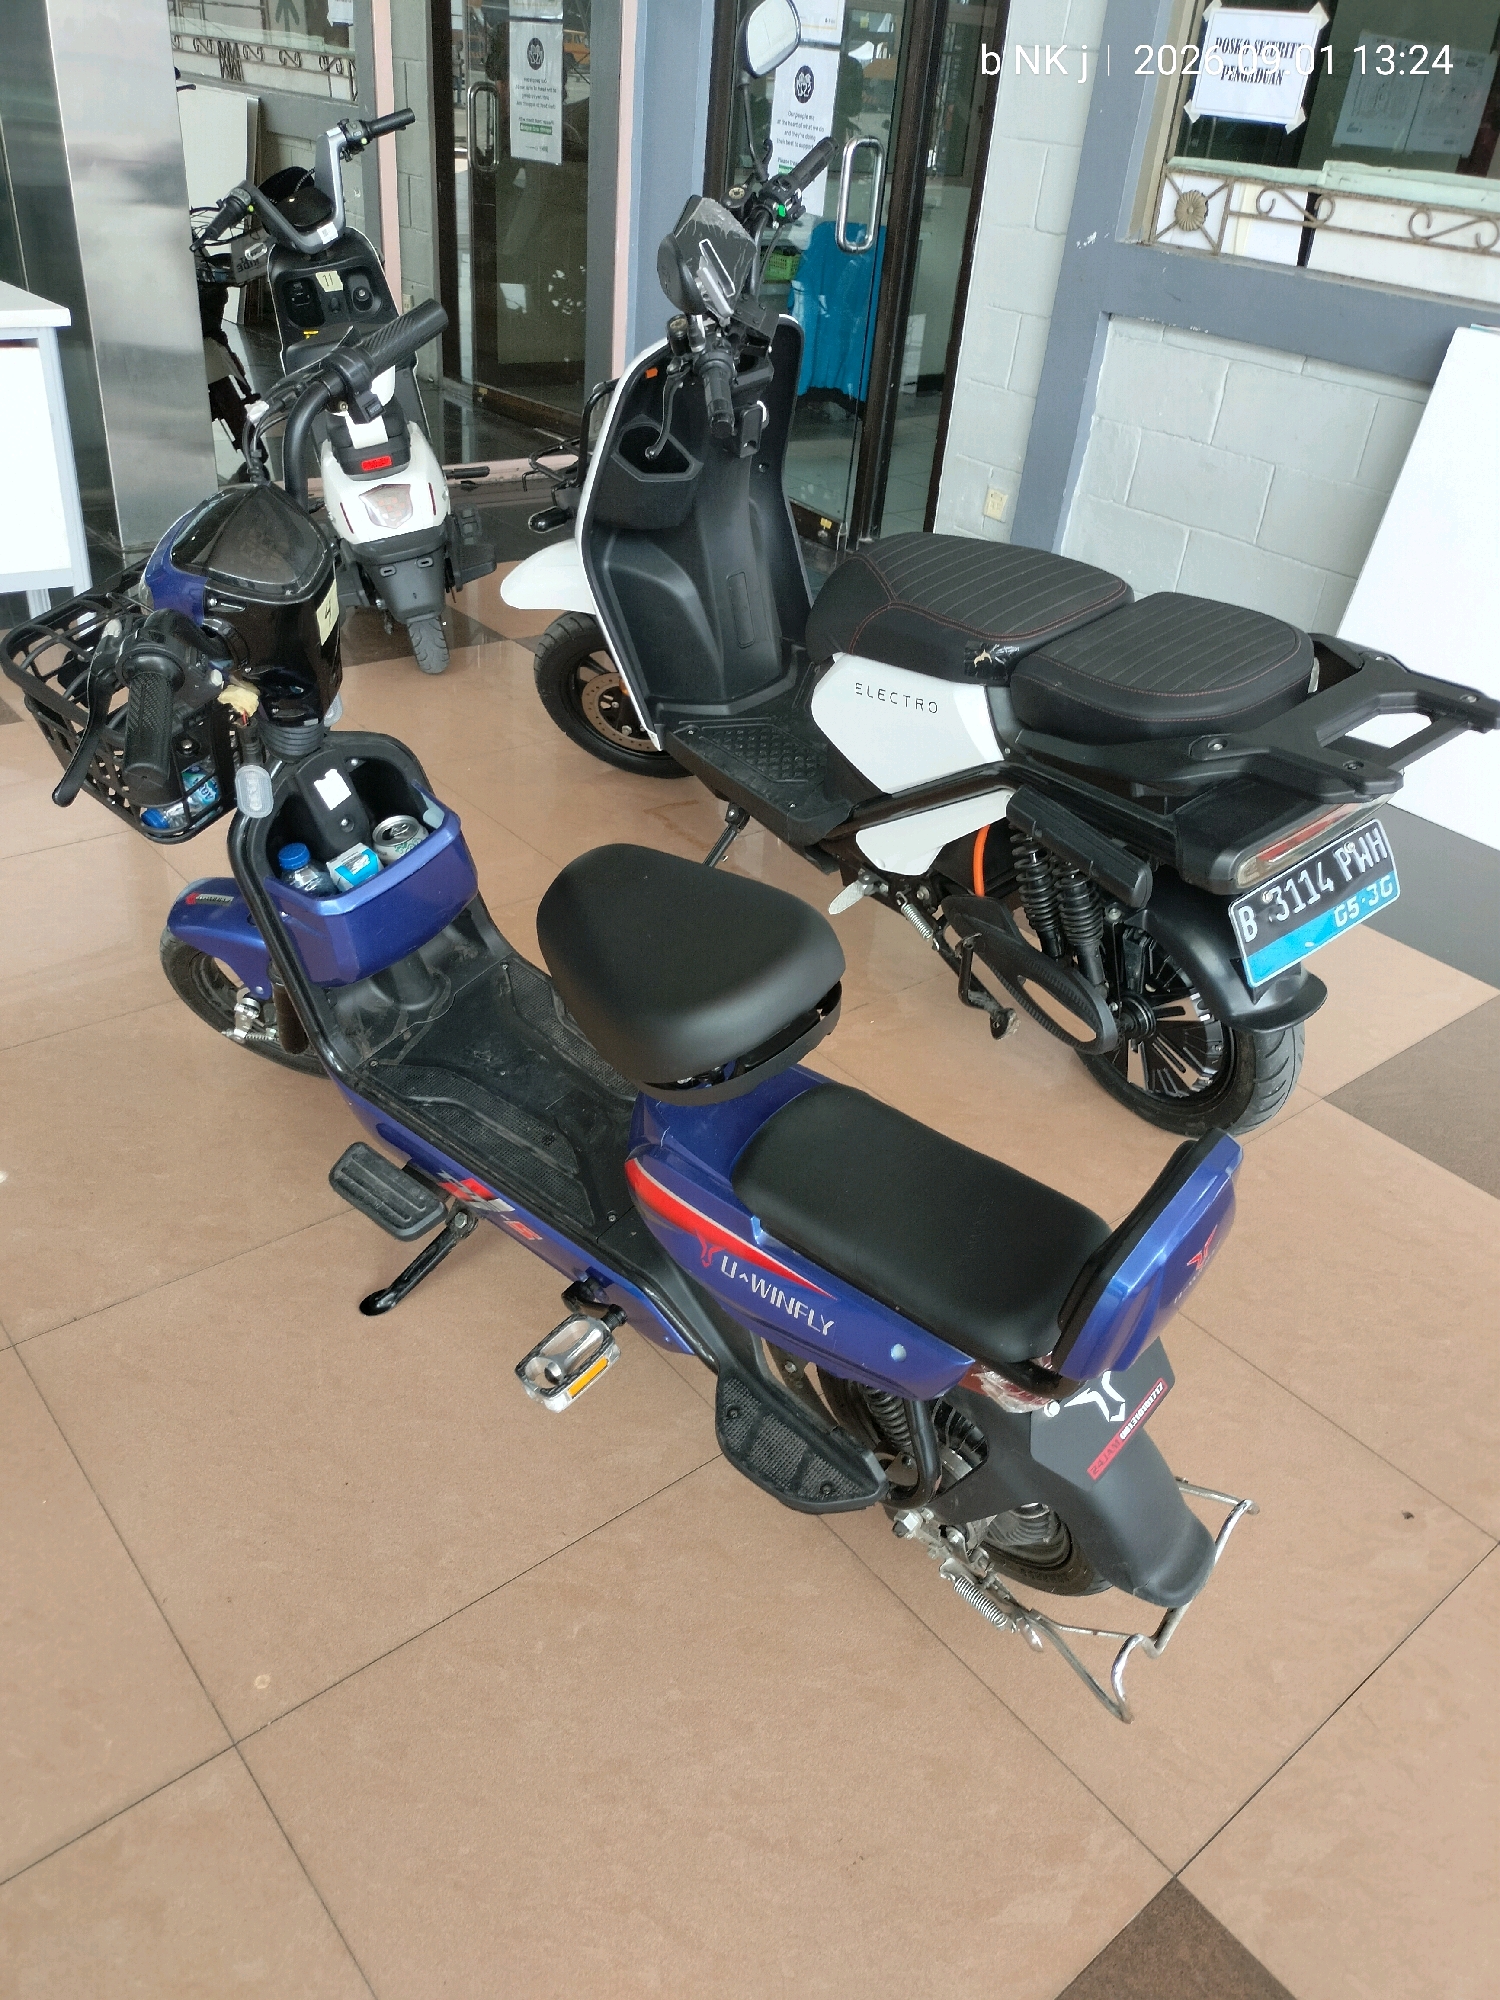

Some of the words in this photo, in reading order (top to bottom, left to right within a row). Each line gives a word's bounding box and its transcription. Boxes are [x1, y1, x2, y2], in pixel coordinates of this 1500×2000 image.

[855, 682, 938, 714] ELECTRO
[1237, 905, 1258, 943] B
[1268, 861, 1335, 923] 3114
[1333, 828, 1388, 882] PWH
